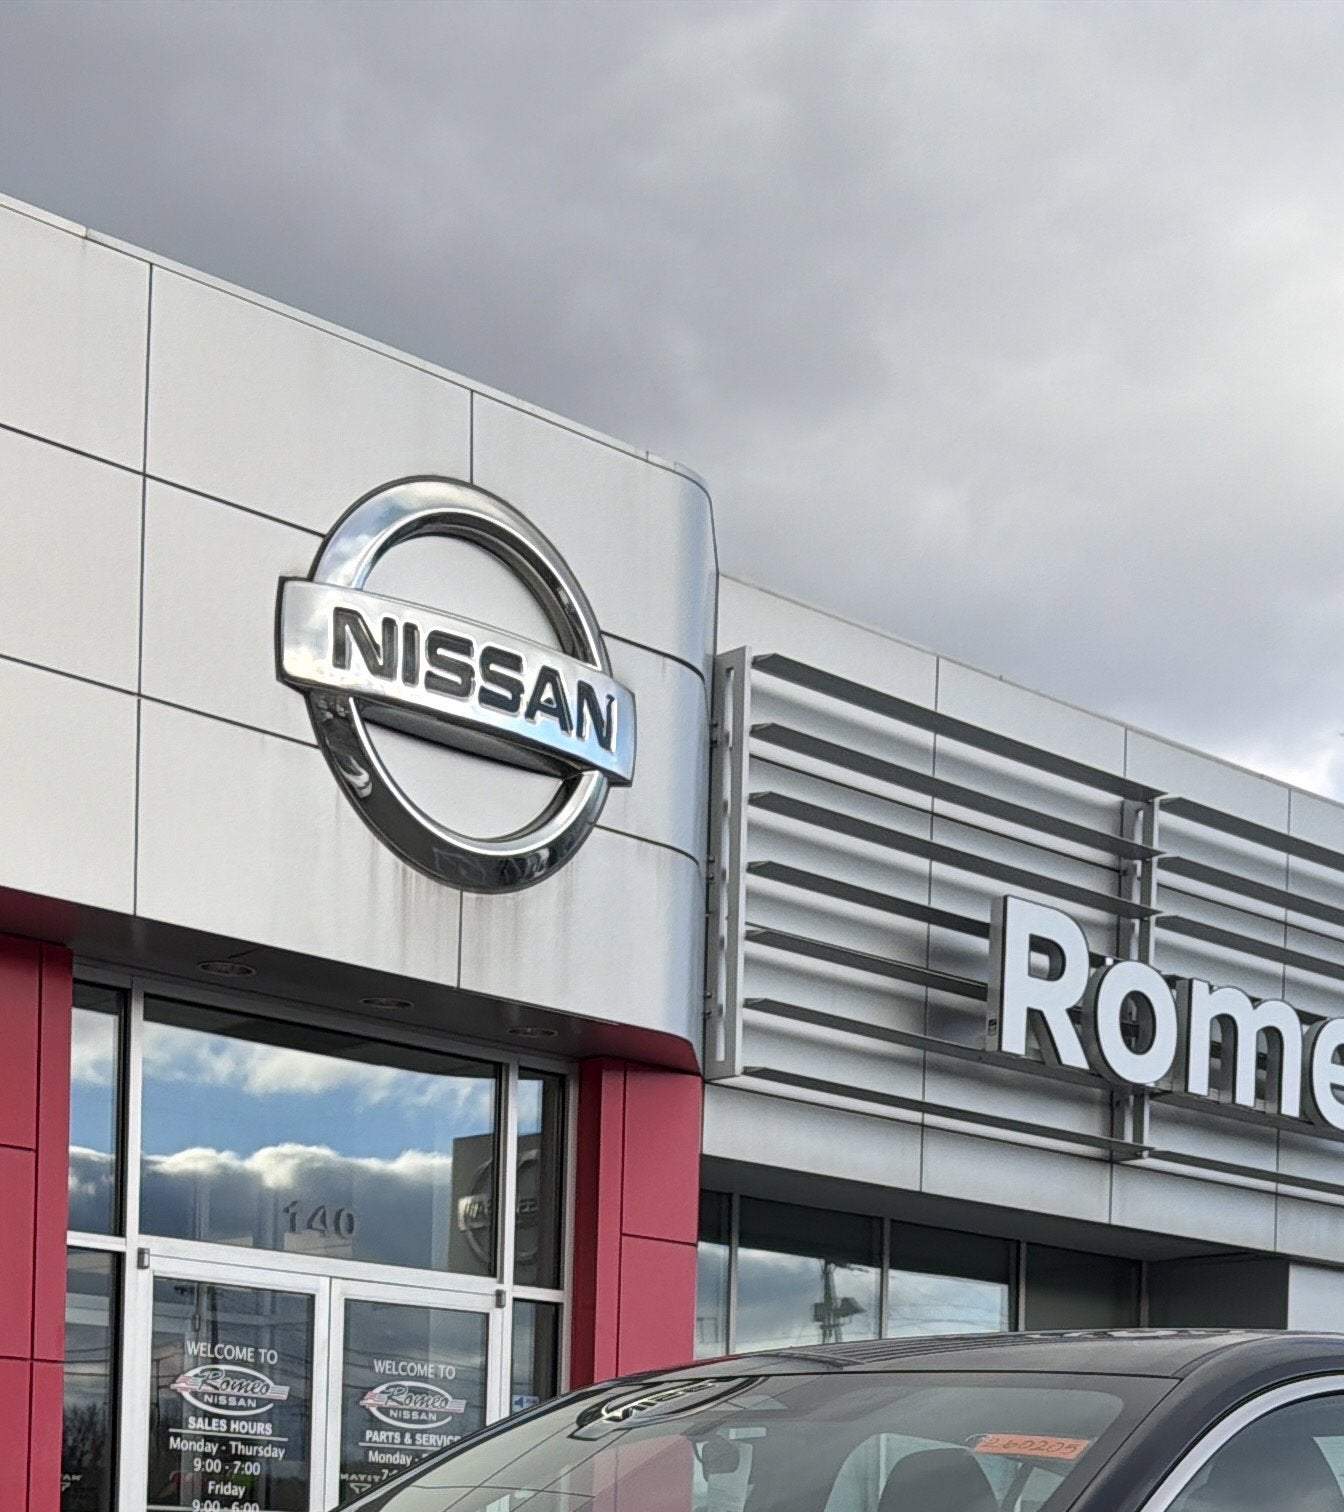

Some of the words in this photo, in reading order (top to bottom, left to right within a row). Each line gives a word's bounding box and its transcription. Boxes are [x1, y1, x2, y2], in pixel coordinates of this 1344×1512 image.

[331, 606, 618, 755] NISSAN
[283, 1200, 355, 1239] 140
[186, 1340, 255, 1363] WELCOME
[258, 1348, 279, 1365] TO
[373, 1359, 435, 1379] WELCOME
[437, 1364, 456, 1380] TO
[193, 1367, 271, 1396] Romeo
[203, 1394, 257, 1408] NISSAN
[384, 1384, 450, 1409] Romeo
[389, 1409, 437, 1421] NISSAN
[187, 1416, 228, 1432] SALES
[230, 1419, 273, 1436] HOURS
[365, 1429, 401, 1445] PARTS
[404, 1432, 413, 1445] &
[169, 1436, 219, 1456] Monday
[229, 1440, 286, 1461] Thursday
[368, 1450, 413, 1467] Monday
[193, 1457, 222, 1473] 9:00
[233, 1460, 261, 1476] 7:00
[207, 1480, 246, 1499] Friday
